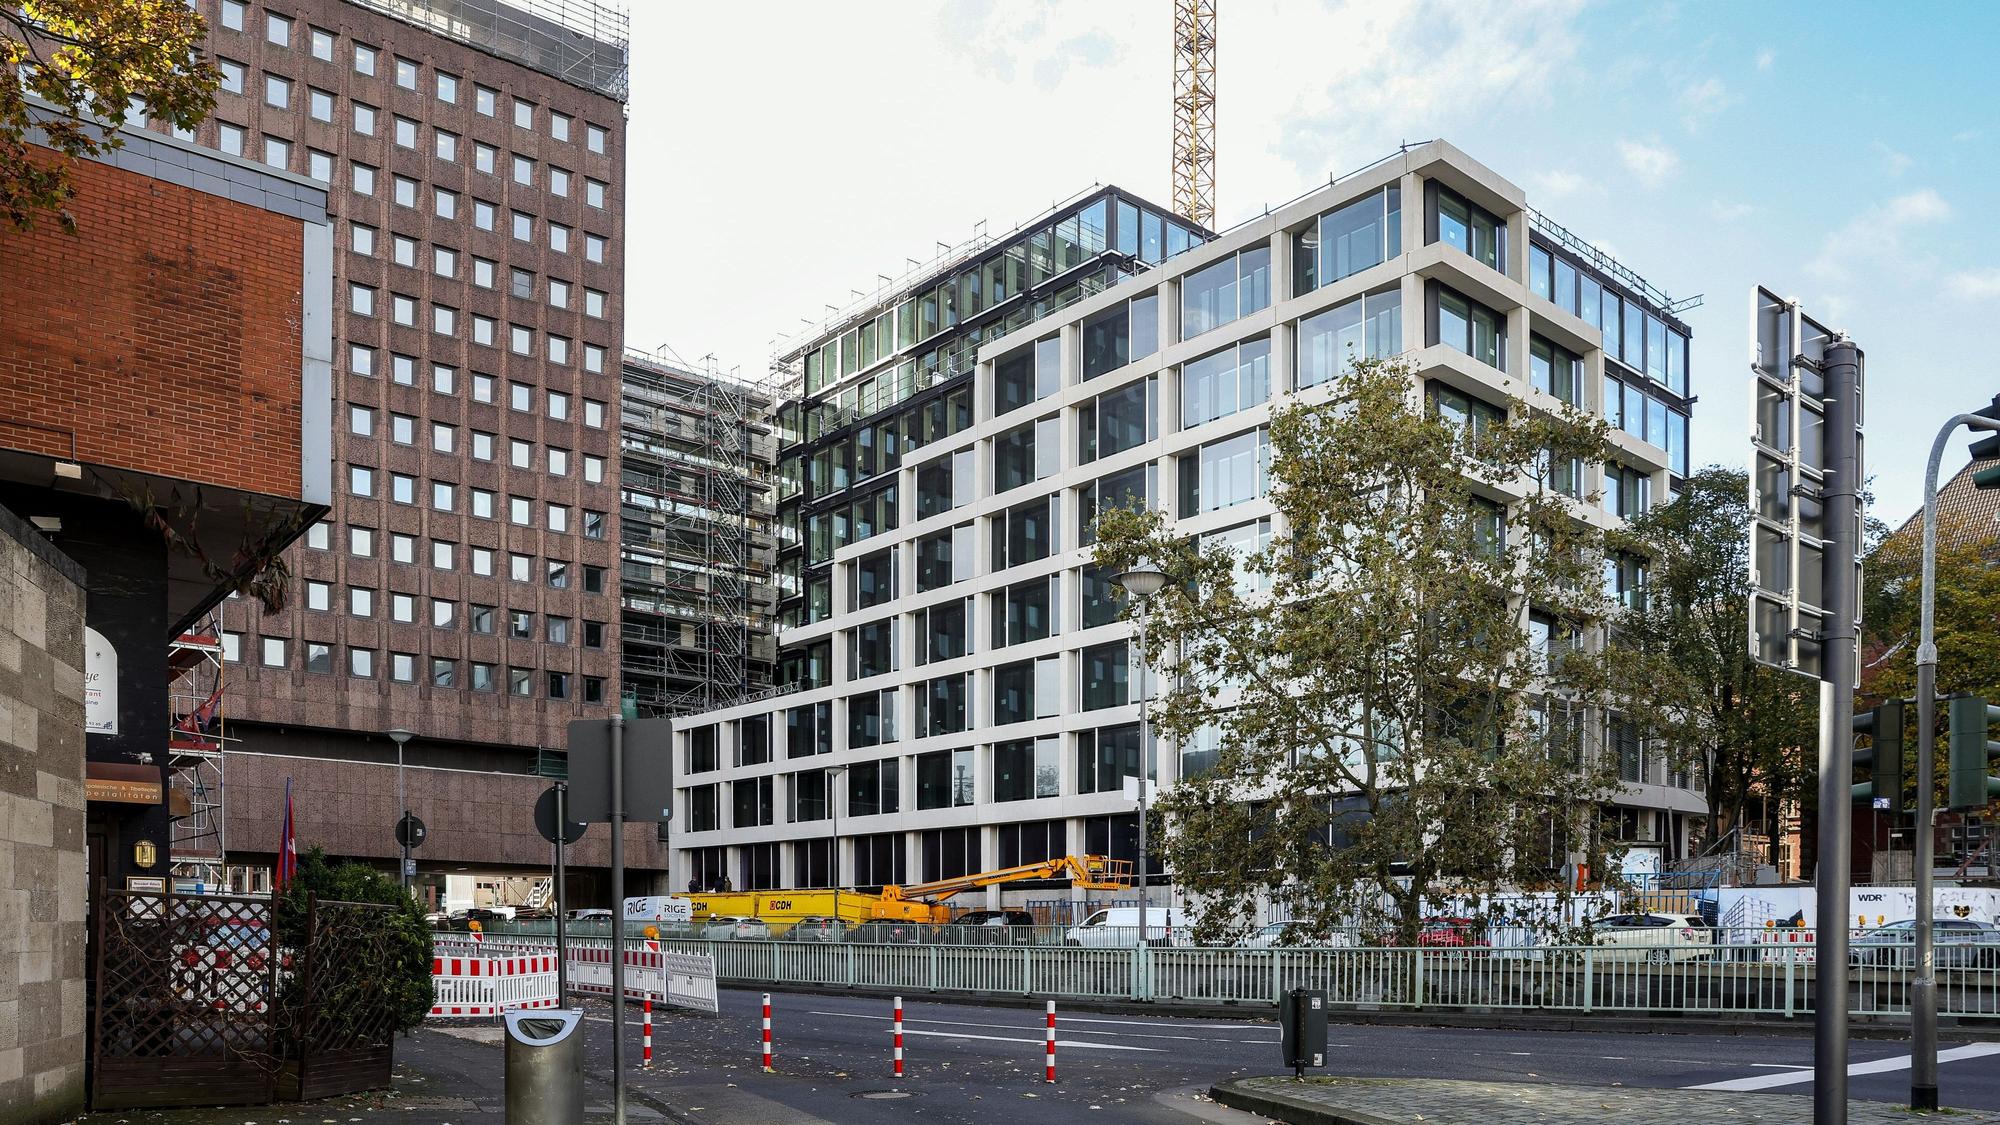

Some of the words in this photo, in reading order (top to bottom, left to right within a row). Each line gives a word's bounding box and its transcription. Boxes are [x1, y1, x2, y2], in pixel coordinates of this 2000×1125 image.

[1858, 894, 1882, 902] WDR
[627, 898, 647, 915] RIGE
[664, 904, 686, 914] RIGE
